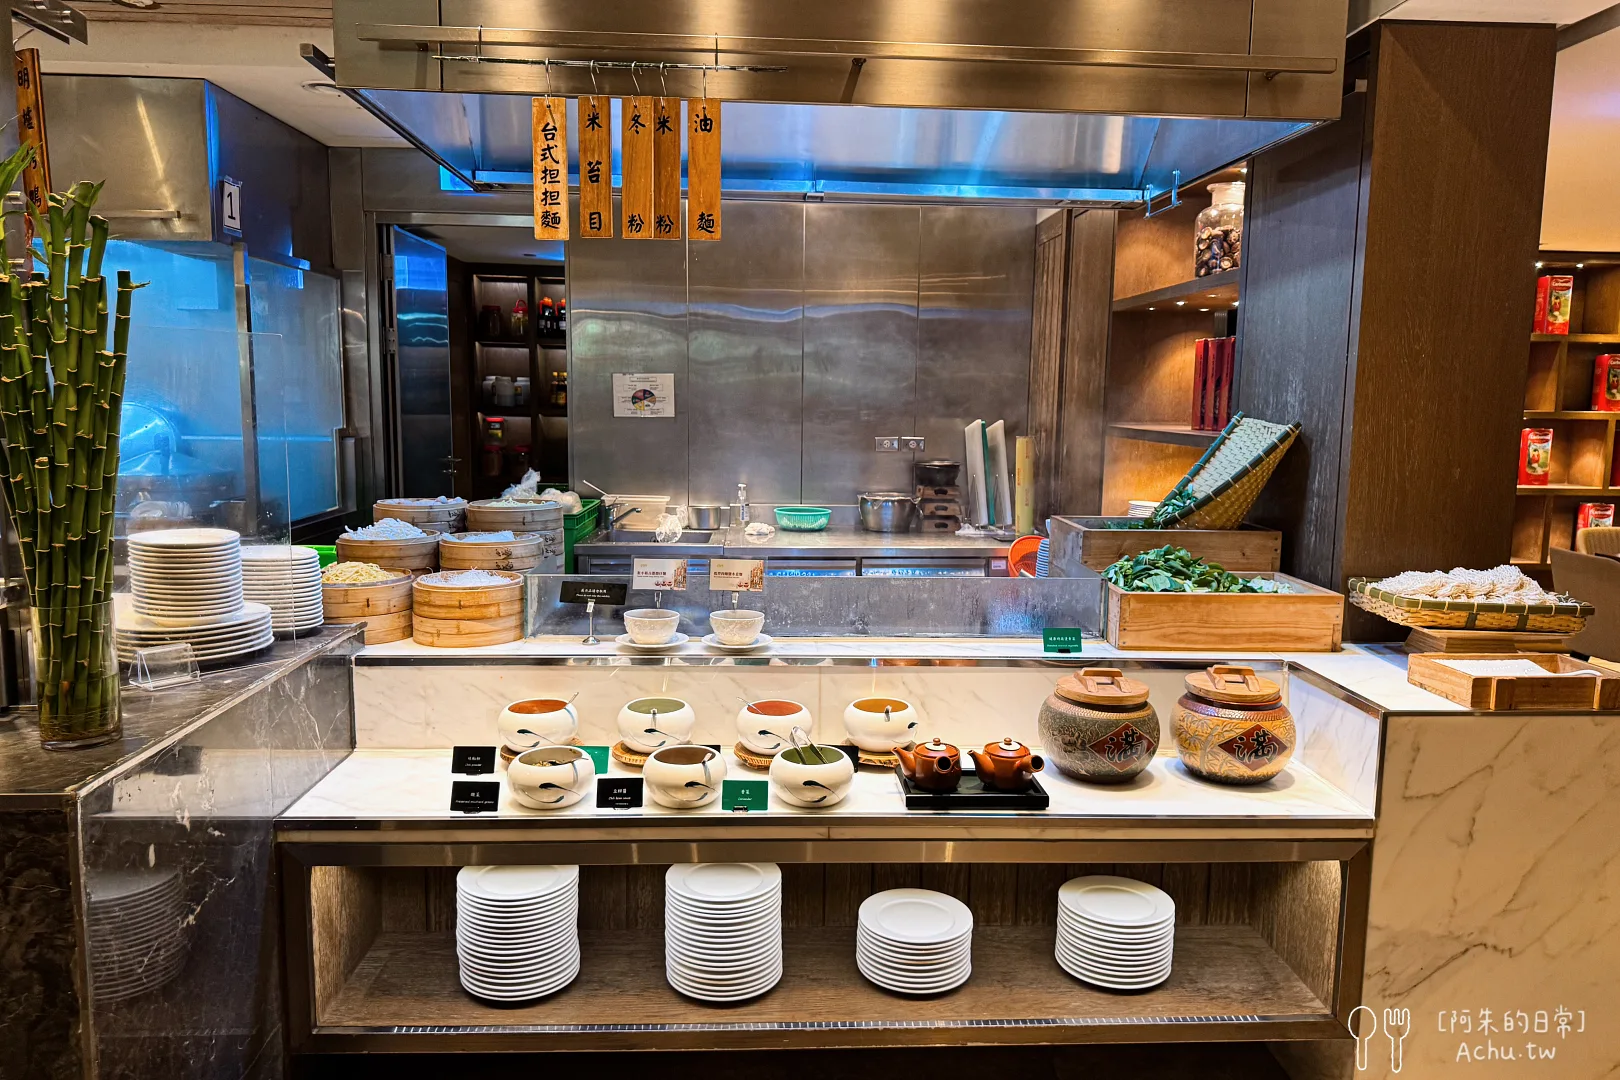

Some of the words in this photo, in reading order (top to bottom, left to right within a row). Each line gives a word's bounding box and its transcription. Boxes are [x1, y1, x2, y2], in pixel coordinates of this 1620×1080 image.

[227, 191, 236, 221] 1
[585, 112, 602, 231] 米苔目
[628, 113, 646, 234] 冬粉
[656, 115, 674, 234] 米粉
[694, 113, 715, 233] 油麵
